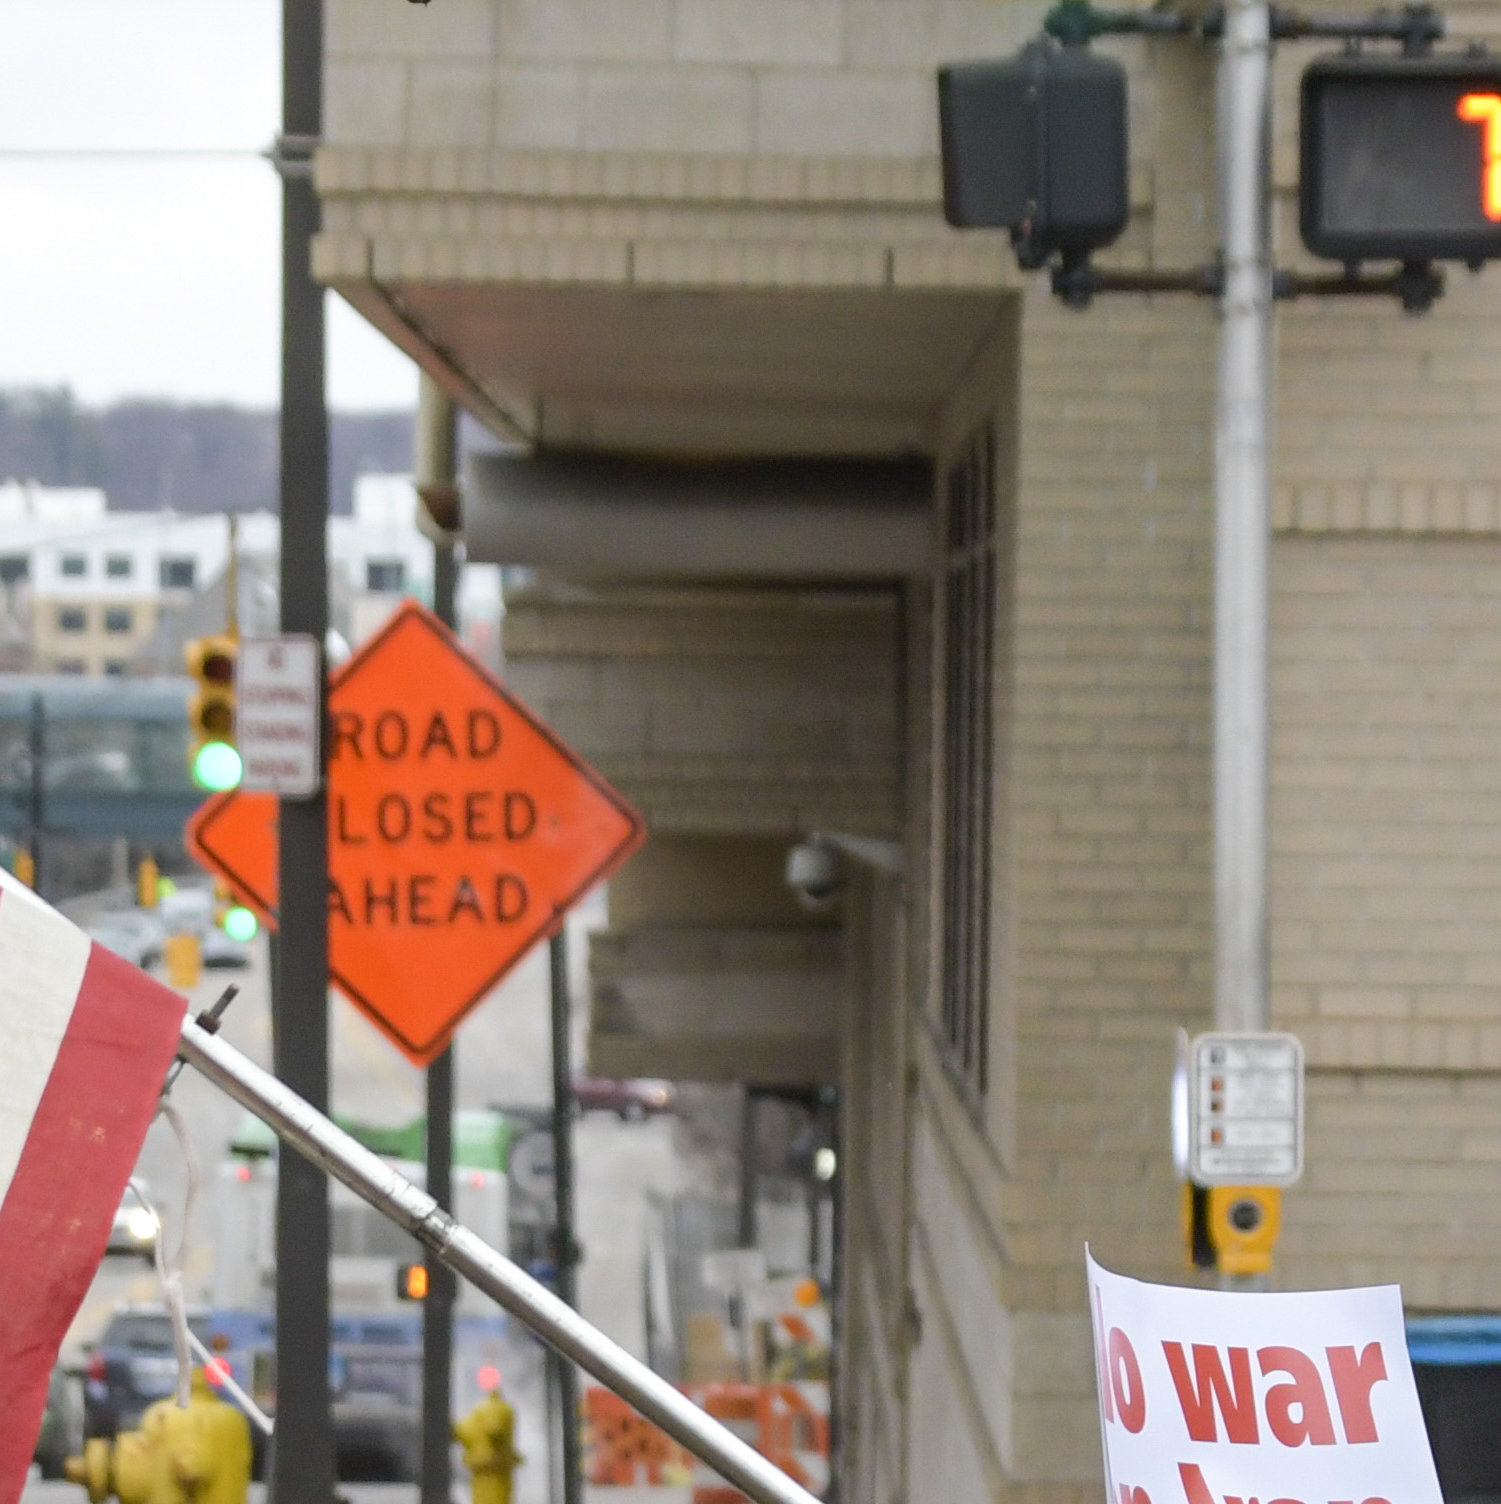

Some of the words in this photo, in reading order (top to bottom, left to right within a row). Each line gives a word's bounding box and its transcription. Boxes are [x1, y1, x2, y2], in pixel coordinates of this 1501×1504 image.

[330, 710, 502, 762] ROAD
[337, 791, 538, 845] LOSED
[1160, 1341, 1389, 1449] war
